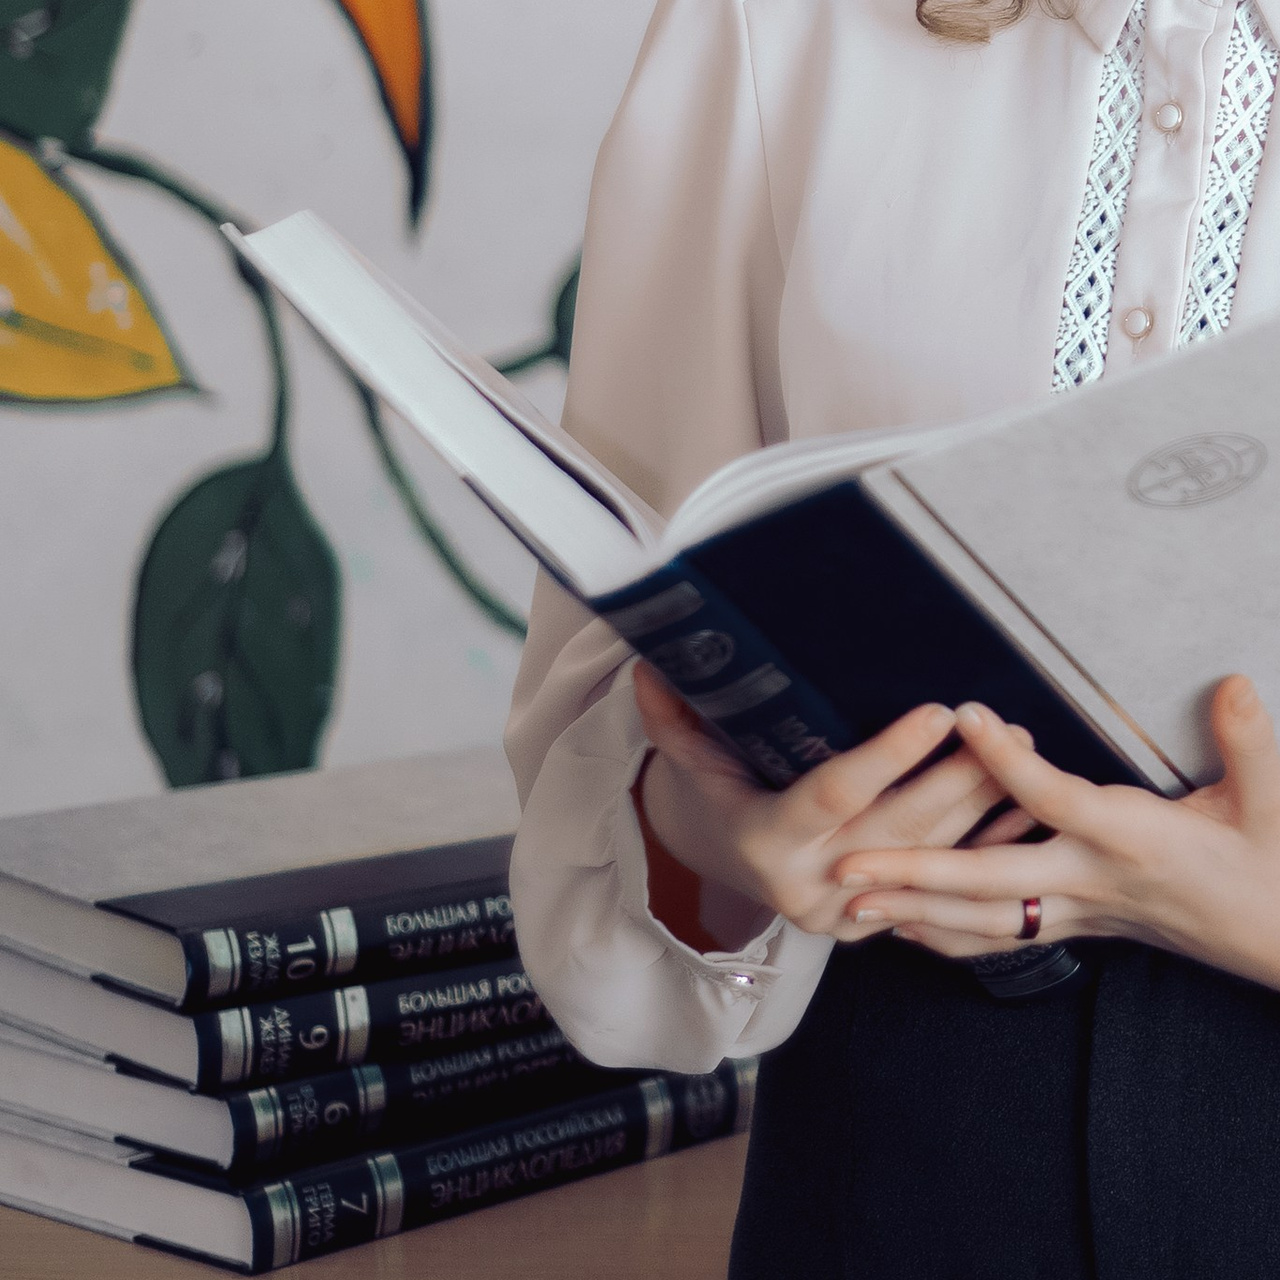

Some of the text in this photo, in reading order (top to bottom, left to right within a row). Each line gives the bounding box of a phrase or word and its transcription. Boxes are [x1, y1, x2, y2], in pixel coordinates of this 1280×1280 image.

[385, 899, 481, 937] БОЛЬШАЯ
[286, 934, 318, 981] 10
[397, 978, 493, 1015] БОЛЬШАЯ
[298, 1023, 331, 1051] 9
[323, 1100, 351, 1126] 6
[427, 1135, 511, 1176] БОЛЬШАЯ
[340, 1191, 369, 1215] 7
